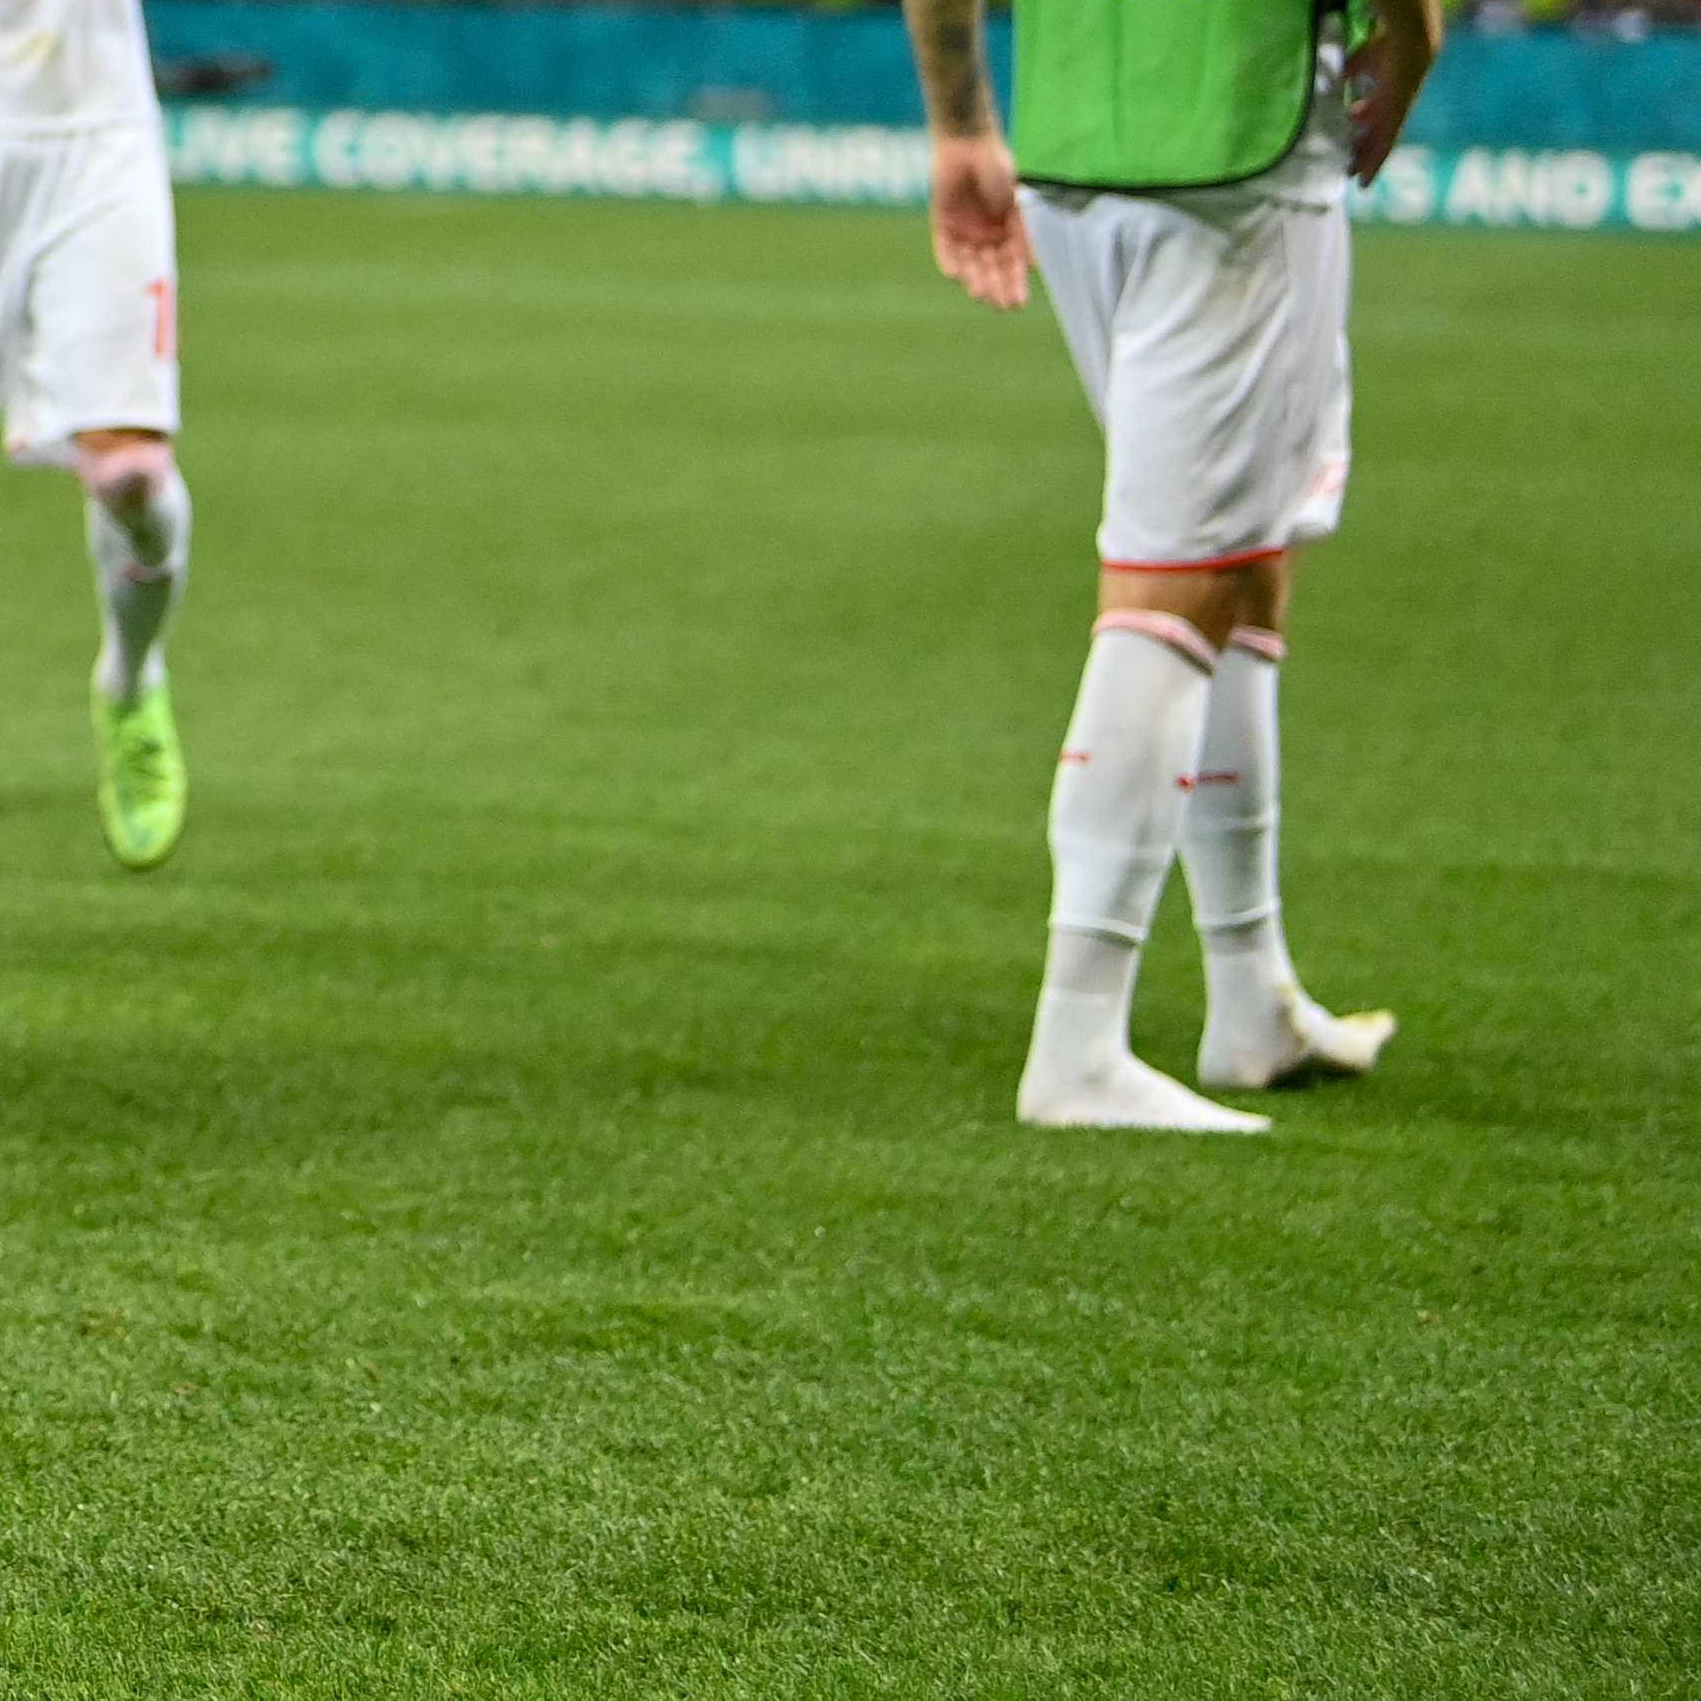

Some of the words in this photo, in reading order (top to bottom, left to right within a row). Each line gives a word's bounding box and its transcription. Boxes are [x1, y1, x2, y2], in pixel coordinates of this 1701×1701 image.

[314, 109, 722, 205] COVERAGE,
[1448, 147, 1612, 229] AND
[144, 277, 175, 360] 1
